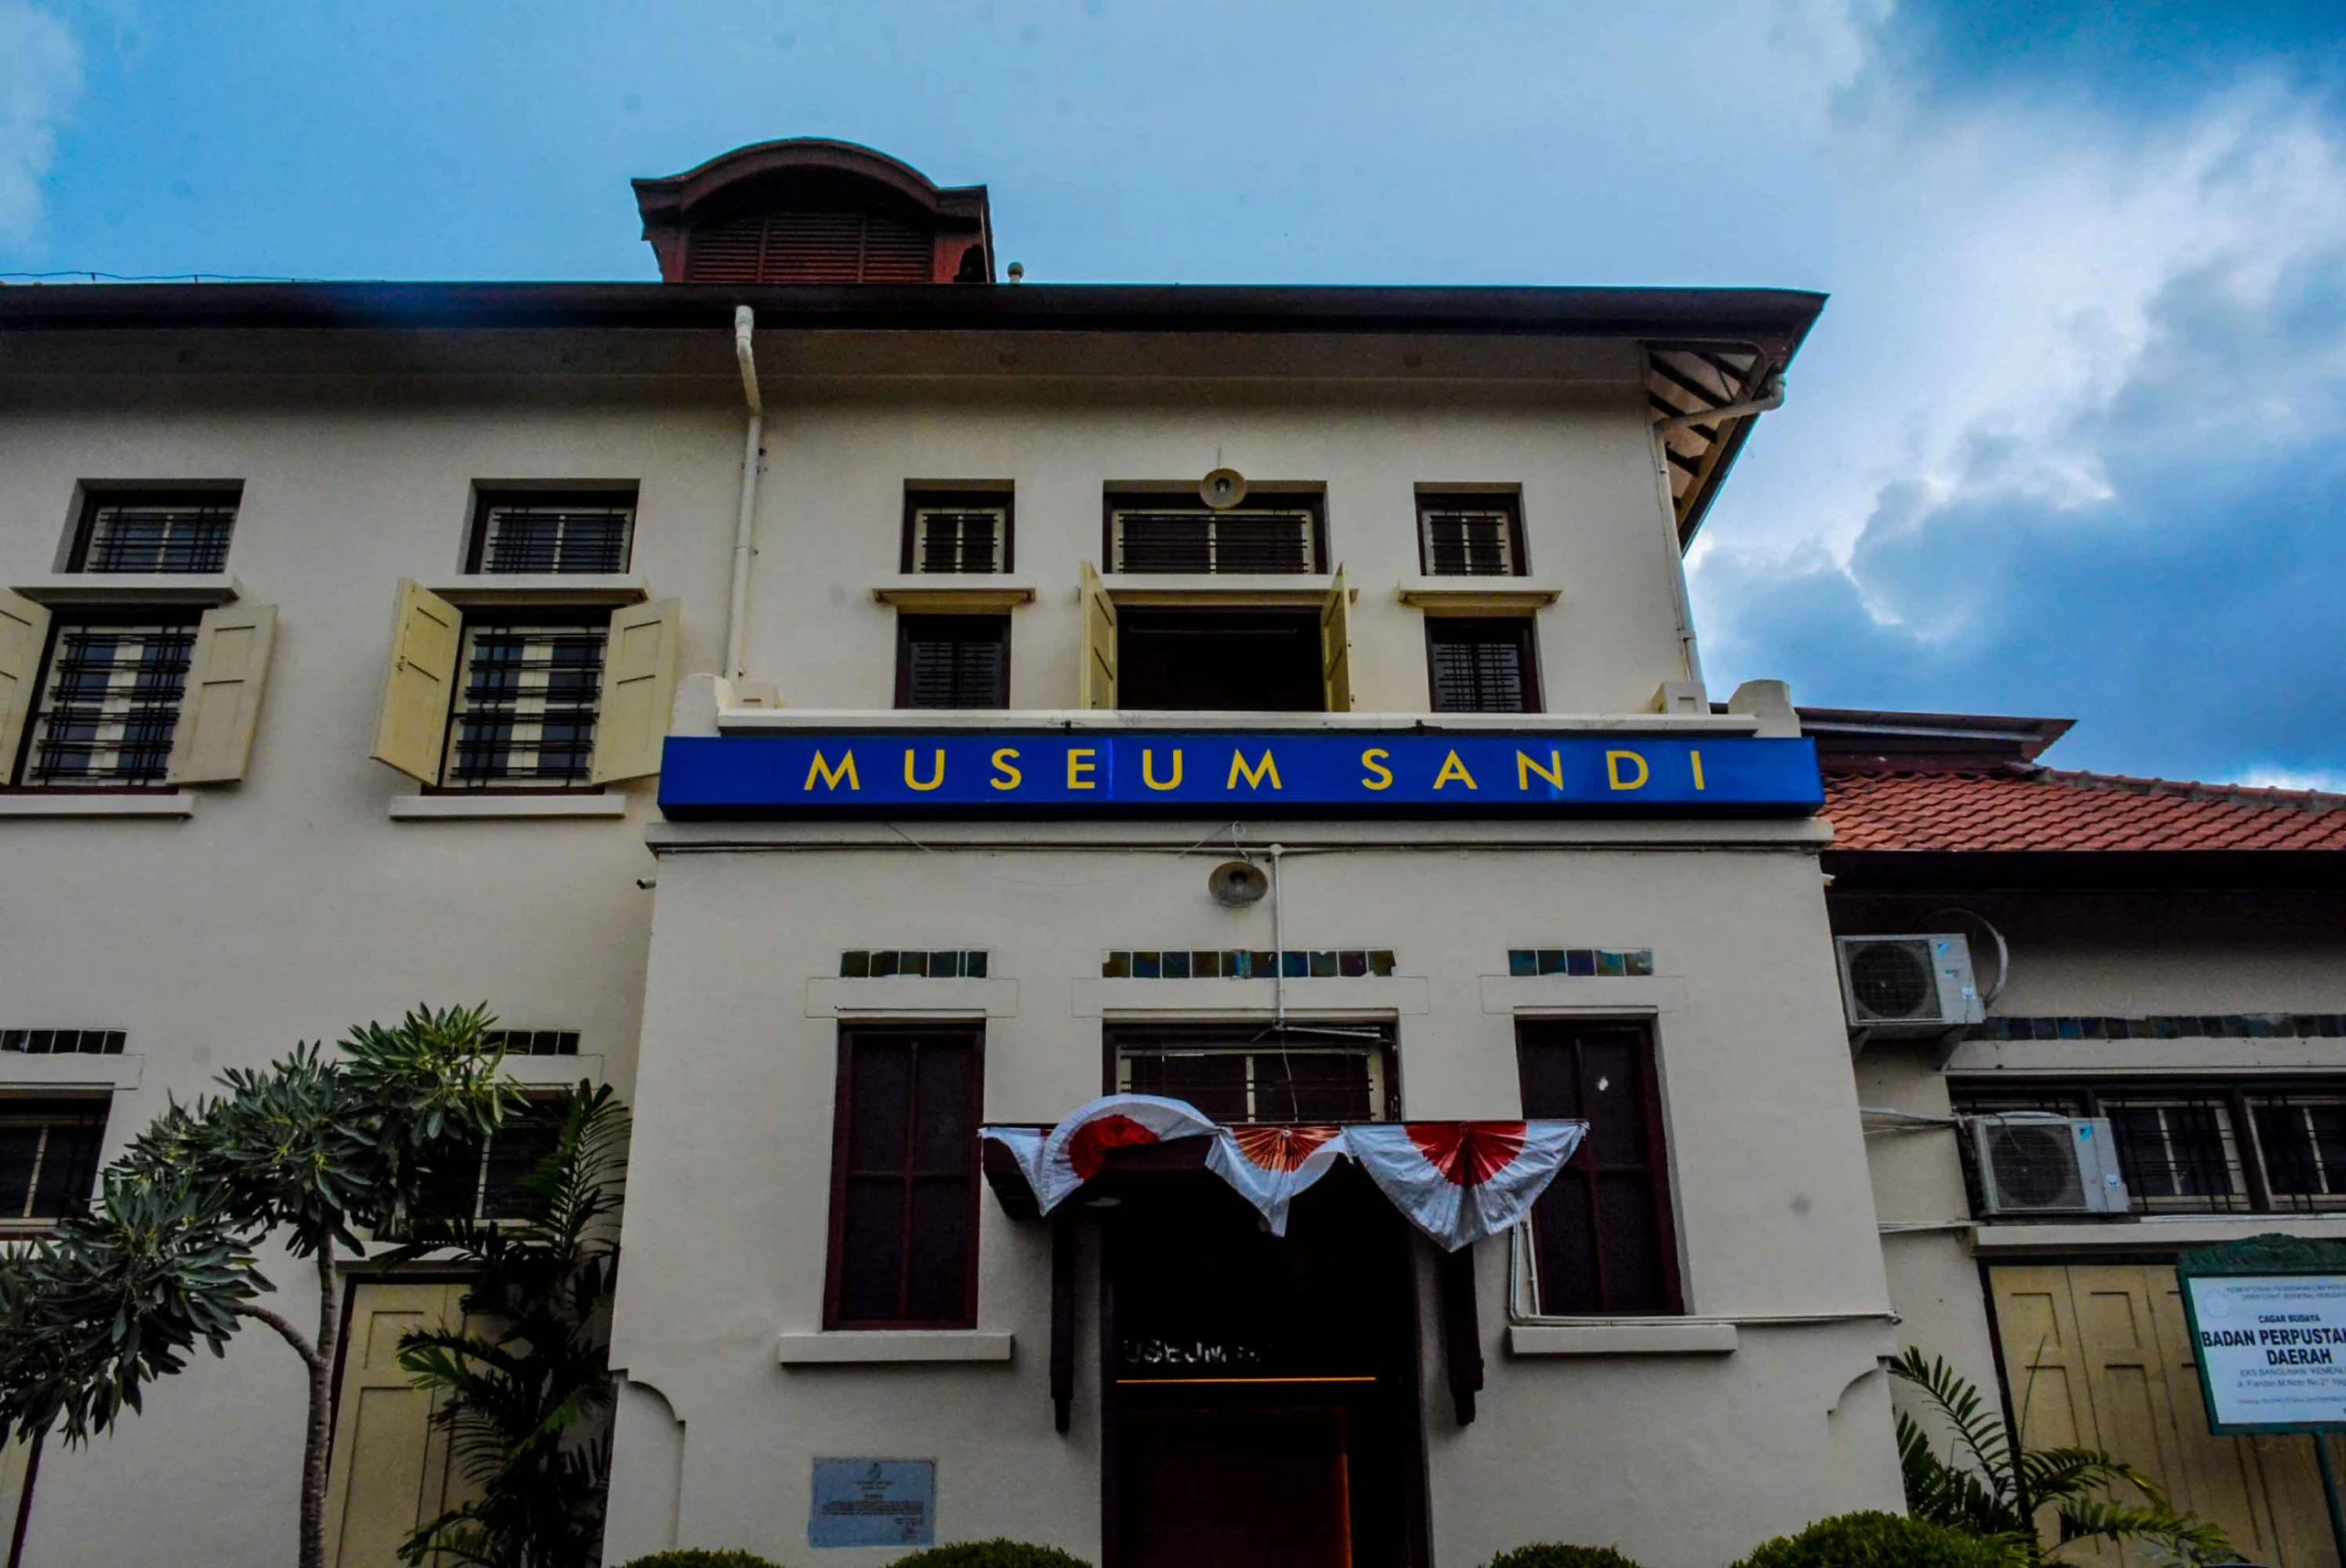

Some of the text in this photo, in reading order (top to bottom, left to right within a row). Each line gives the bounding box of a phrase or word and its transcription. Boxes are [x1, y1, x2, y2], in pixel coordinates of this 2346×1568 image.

[806, 749, 1705, 790] MUSEUM SANDI
[2201, 1330, 2256, 1347] BADAN
[2266, 1348, 2332, 1365] DAERAH
